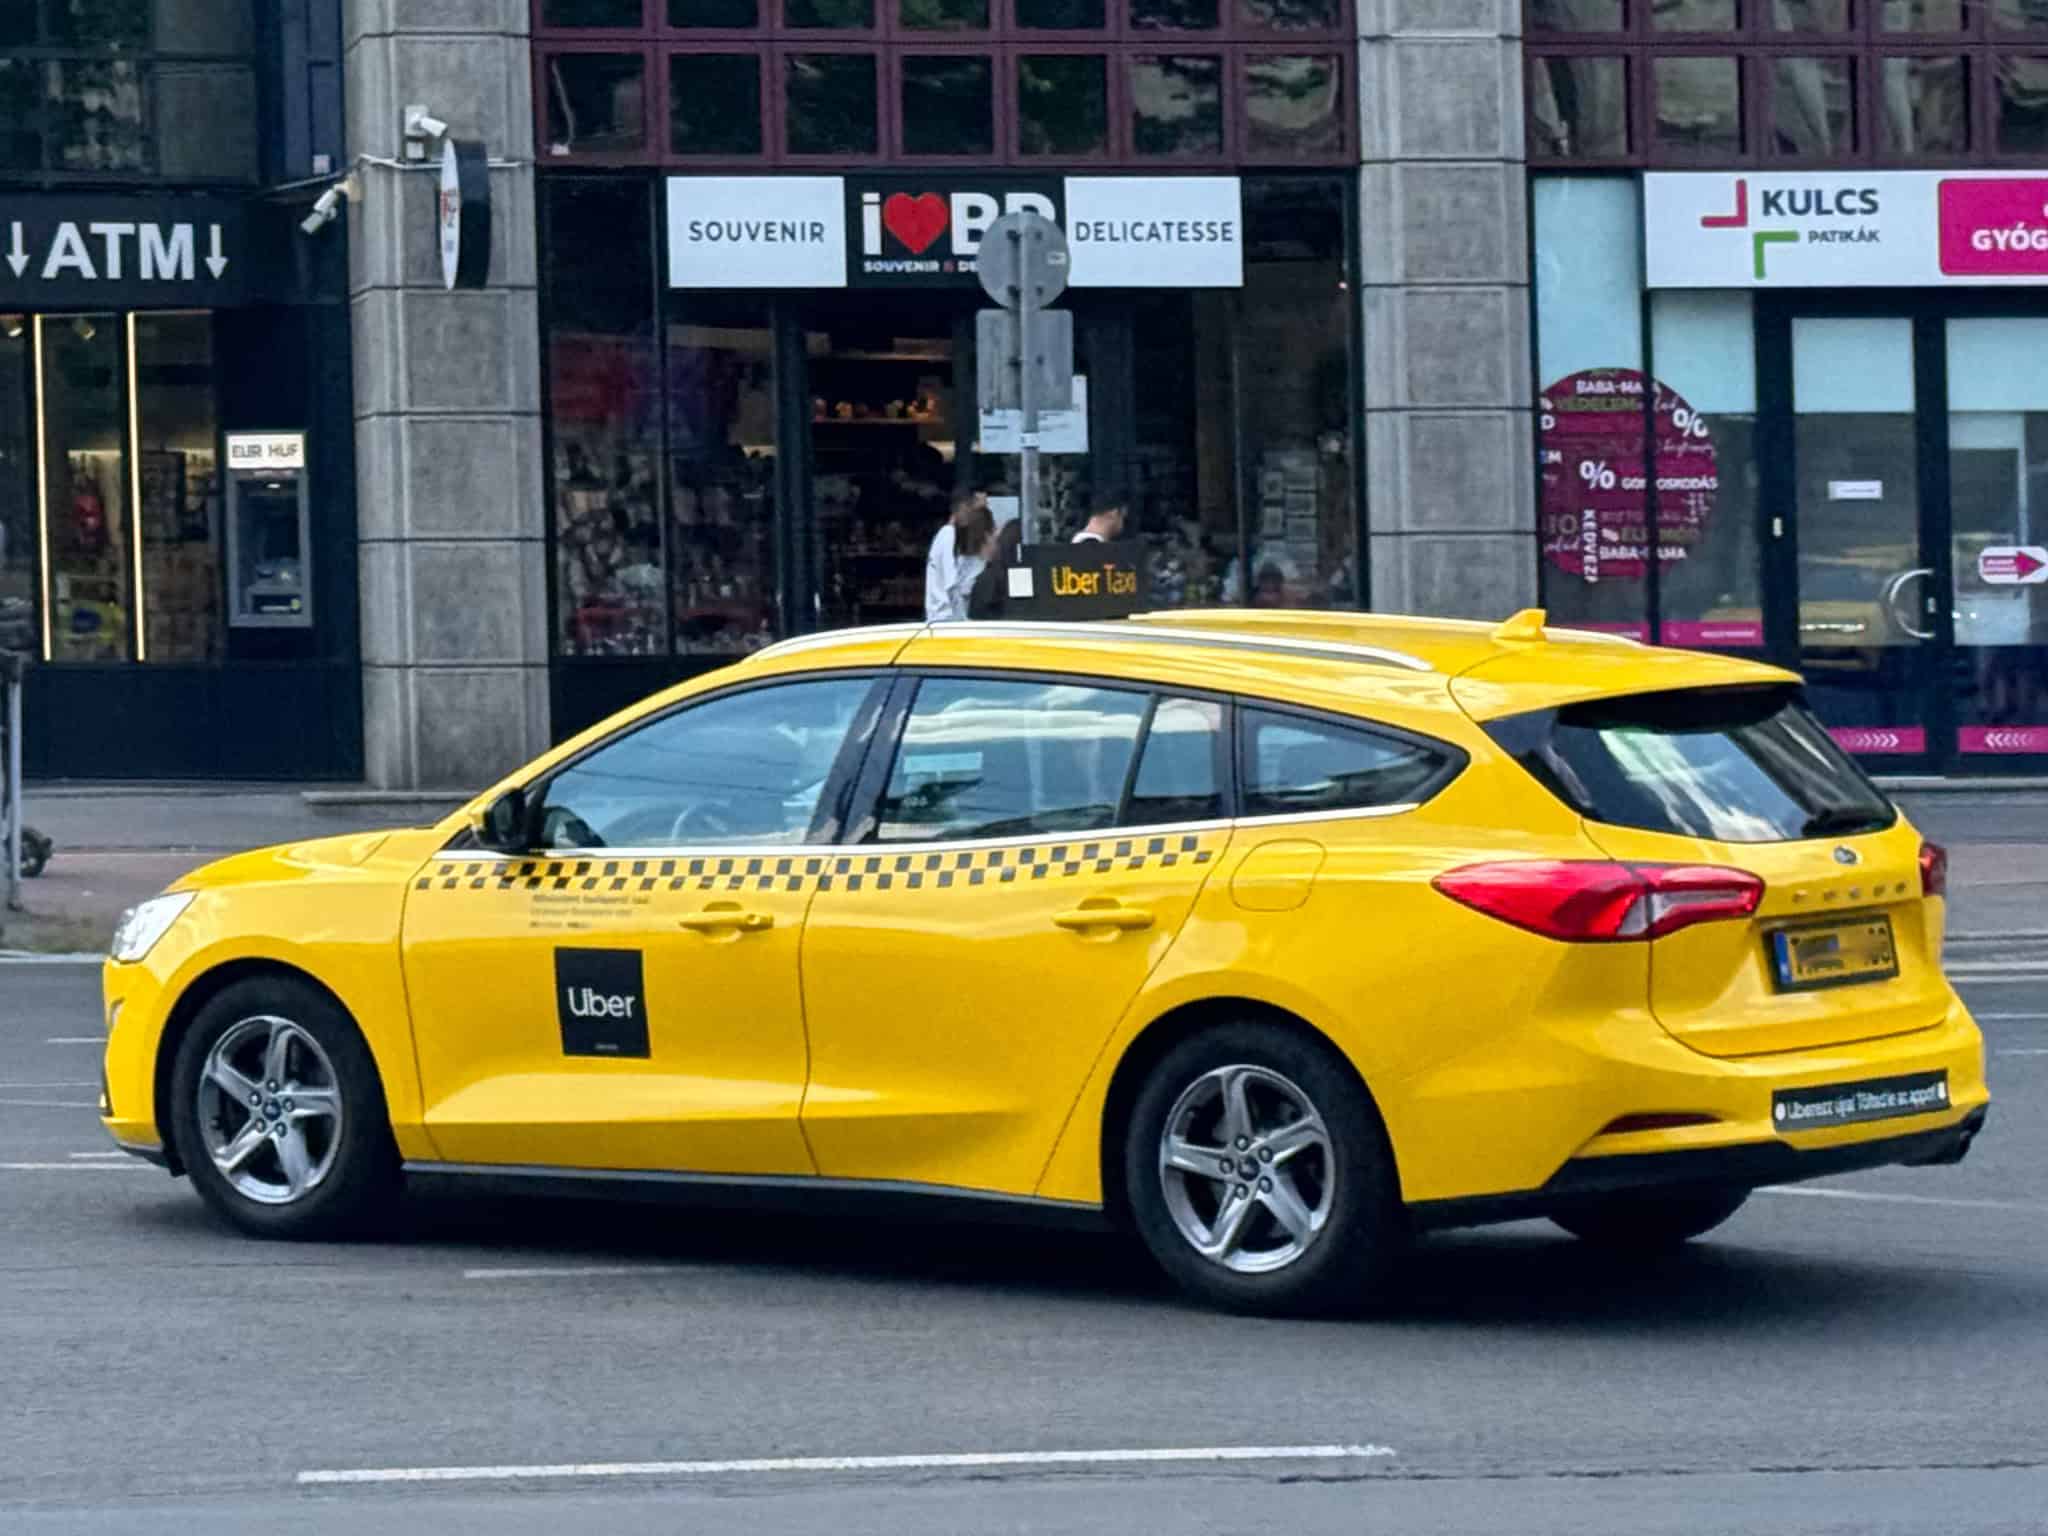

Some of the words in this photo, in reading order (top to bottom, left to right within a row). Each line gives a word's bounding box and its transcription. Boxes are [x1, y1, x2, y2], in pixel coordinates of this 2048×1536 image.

[1762, 188, 1879, 216] KULCS
[688, 220, 825, 242] SOUVENIR
[1075, 220, 1234, 243] DELICATESSE
[1808, 225, 1880, 243] PATIKÁK
[41, 222, 195, 280] ATM
[864, 260, 940, 272] SOUVENIR
[231, 444, 262, 458] EUR
[267, 443, 298, 457] HUF
[1052, 566, 1100, 595] Uber
[568, 987, 635, 1018] Uber
